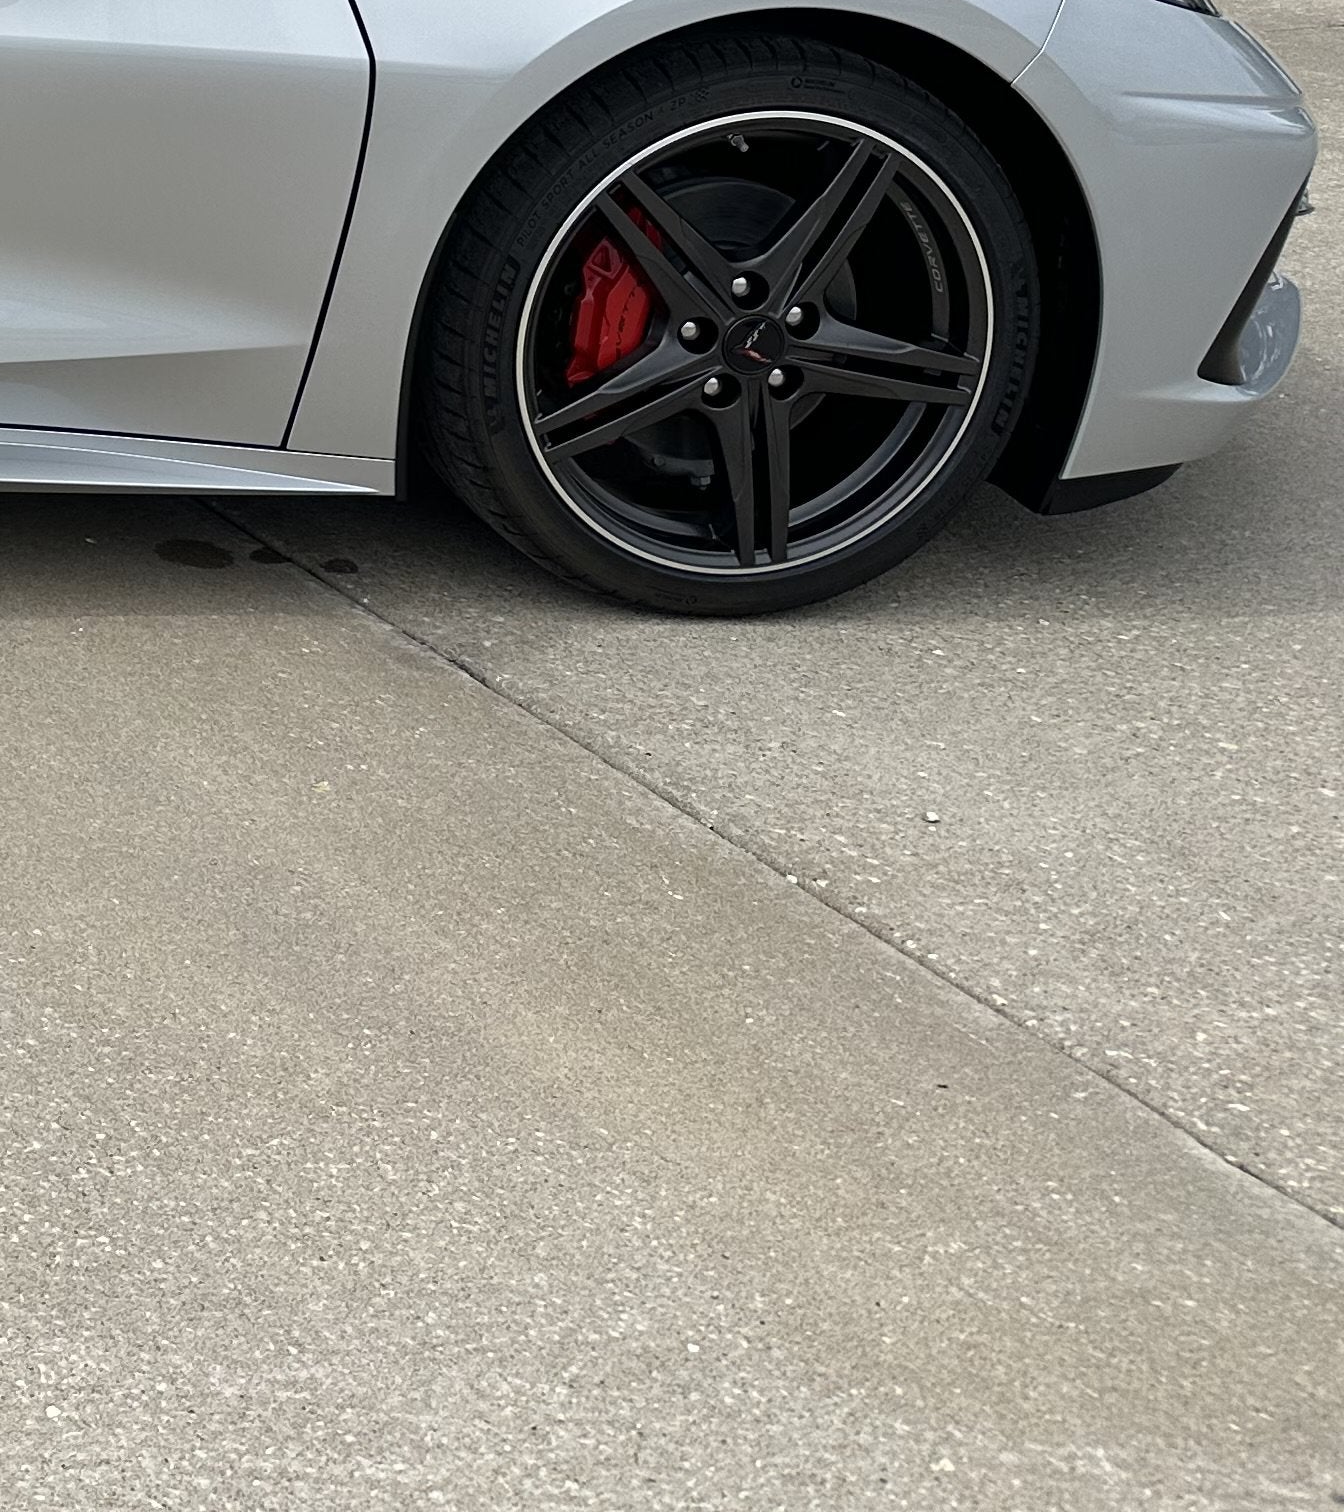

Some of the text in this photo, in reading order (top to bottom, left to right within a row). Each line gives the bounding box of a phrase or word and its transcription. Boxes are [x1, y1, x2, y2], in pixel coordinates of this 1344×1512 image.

[516, 210, 541, 247] PILOT
[541, 172, 573, 209] SPORT
[575, 148, 601, 169] ALL
[603, 111, 654, 148] SEASON
[900, 201, 943, 294] CORVETTE
[483, 259, 519, 397] MICHELIN
